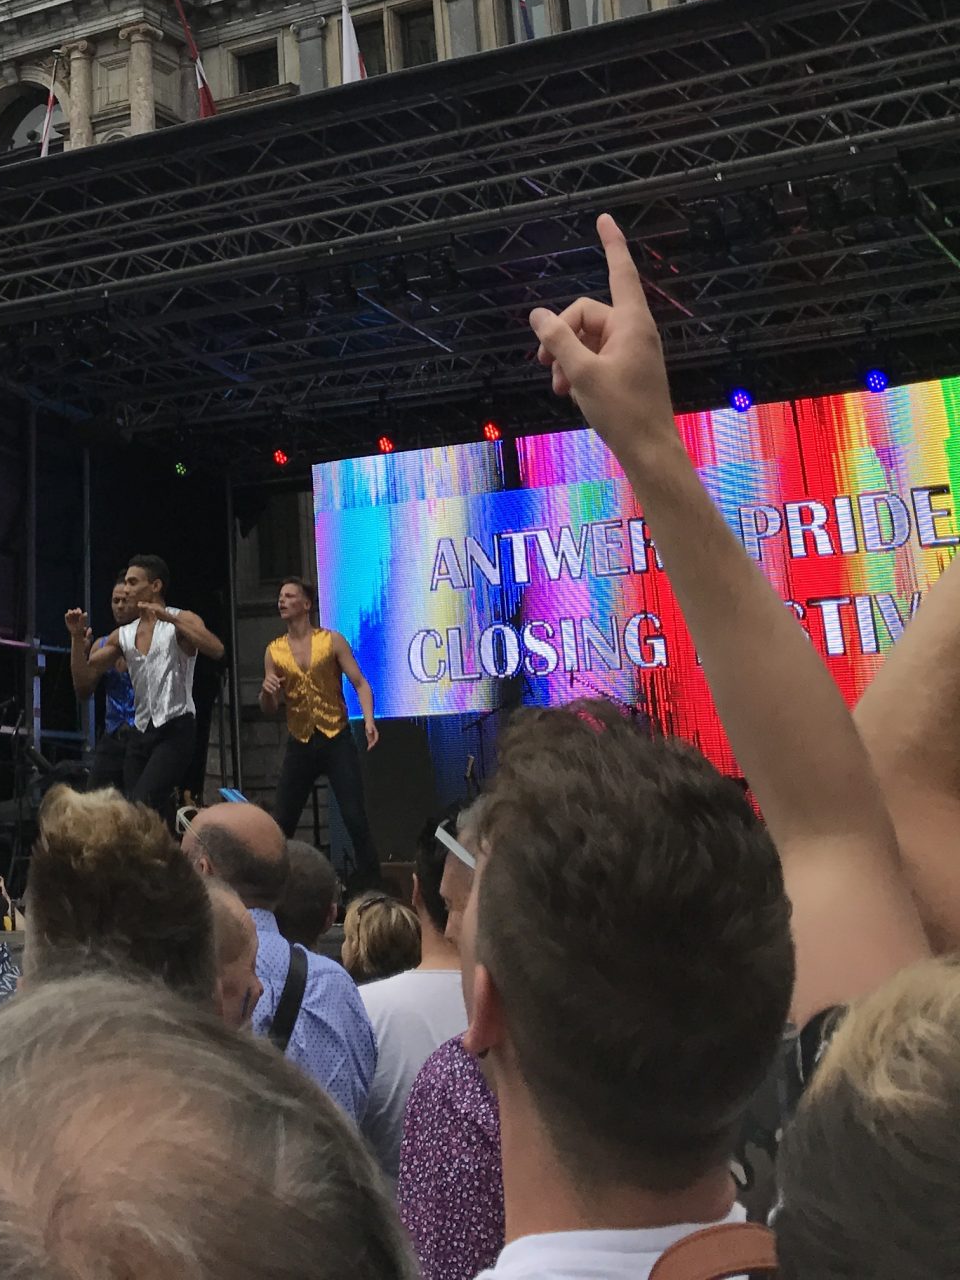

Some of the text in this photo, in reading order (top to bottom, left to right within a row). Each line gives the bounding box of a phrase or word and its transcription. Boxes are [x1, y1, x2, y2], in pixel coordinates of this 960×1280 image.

[430, 484, 960, 591] ANTWER PRIDE
[407, 609, 669, 684] CLOSING
